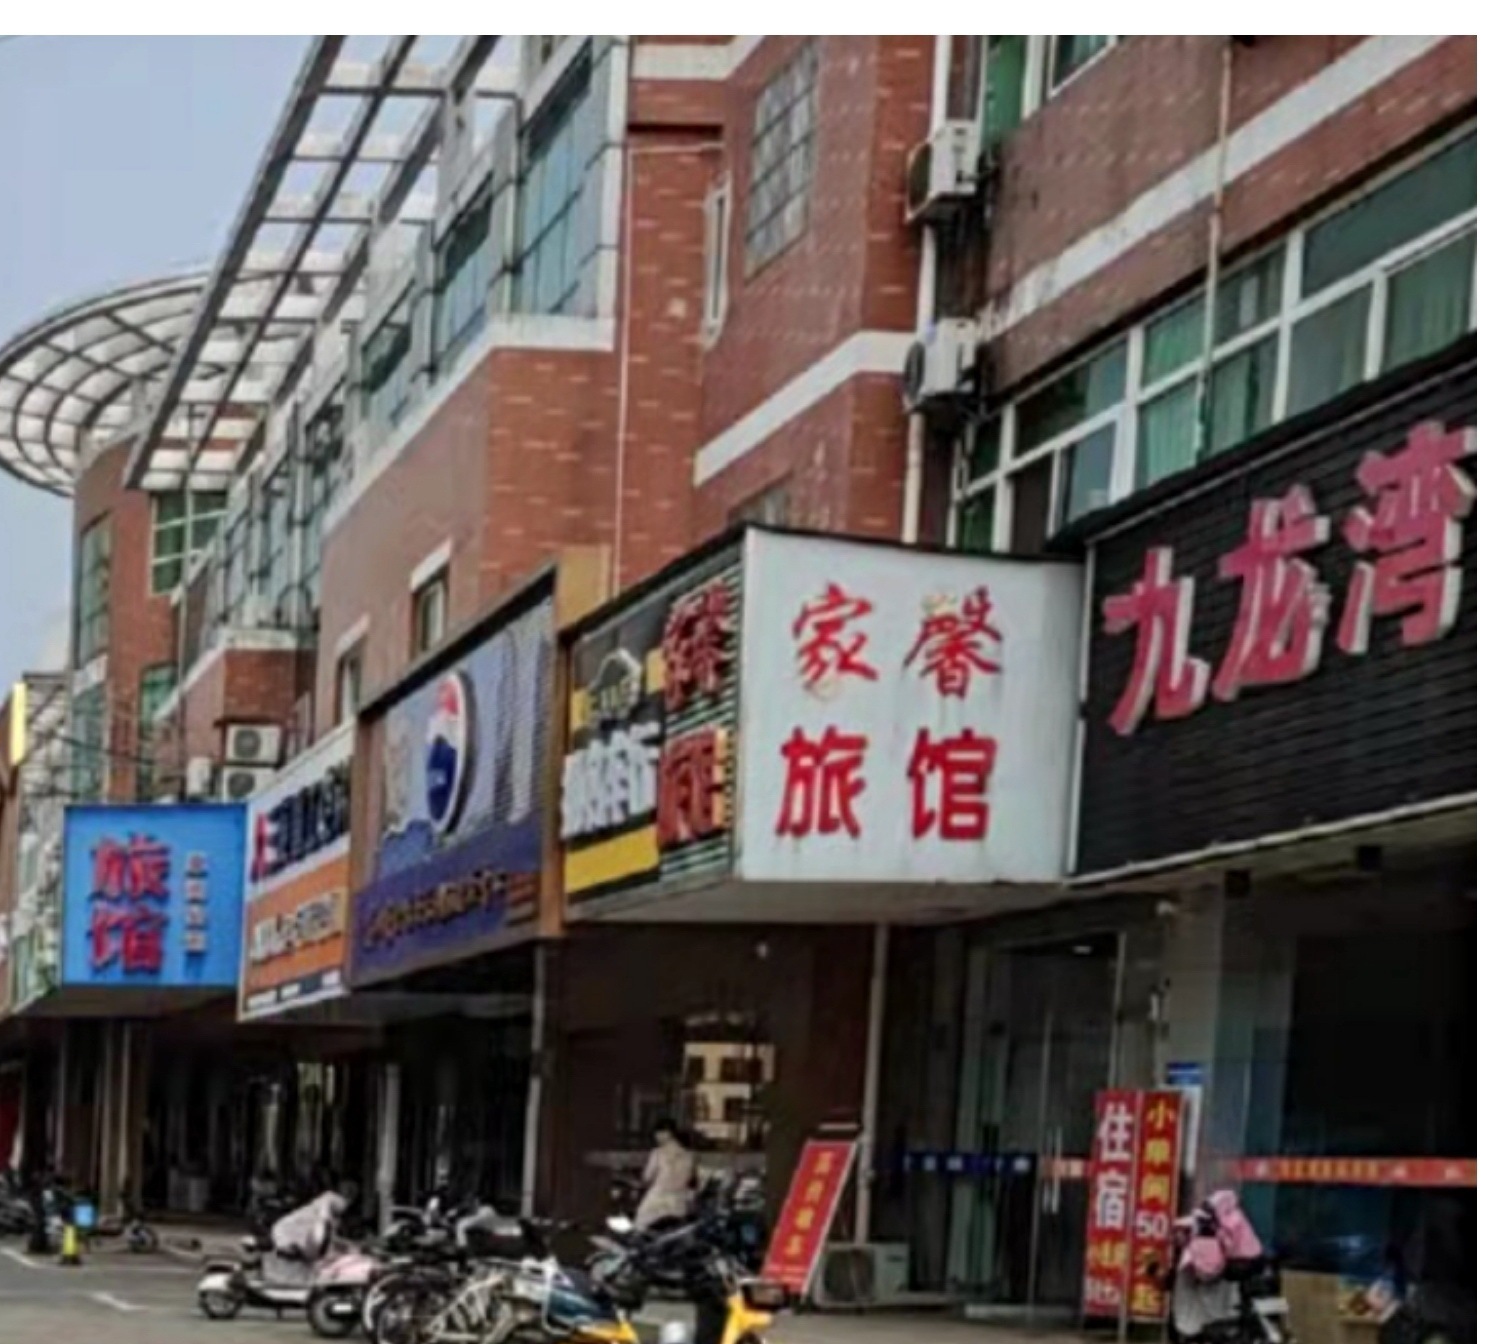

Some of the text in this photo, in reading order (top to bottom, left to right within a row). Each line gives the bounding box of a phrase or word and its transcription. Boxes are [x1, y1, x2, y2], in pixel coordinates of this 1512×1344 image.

[792, 582, 1006, 700] 家馨
[1102, 420, 1476, 736] 九龙湾
[775, 726, 997, 842] 旅馆
[89, 832, 172, 974] 旅馆
[1096, 1101, 1134, 1230] 住宿
